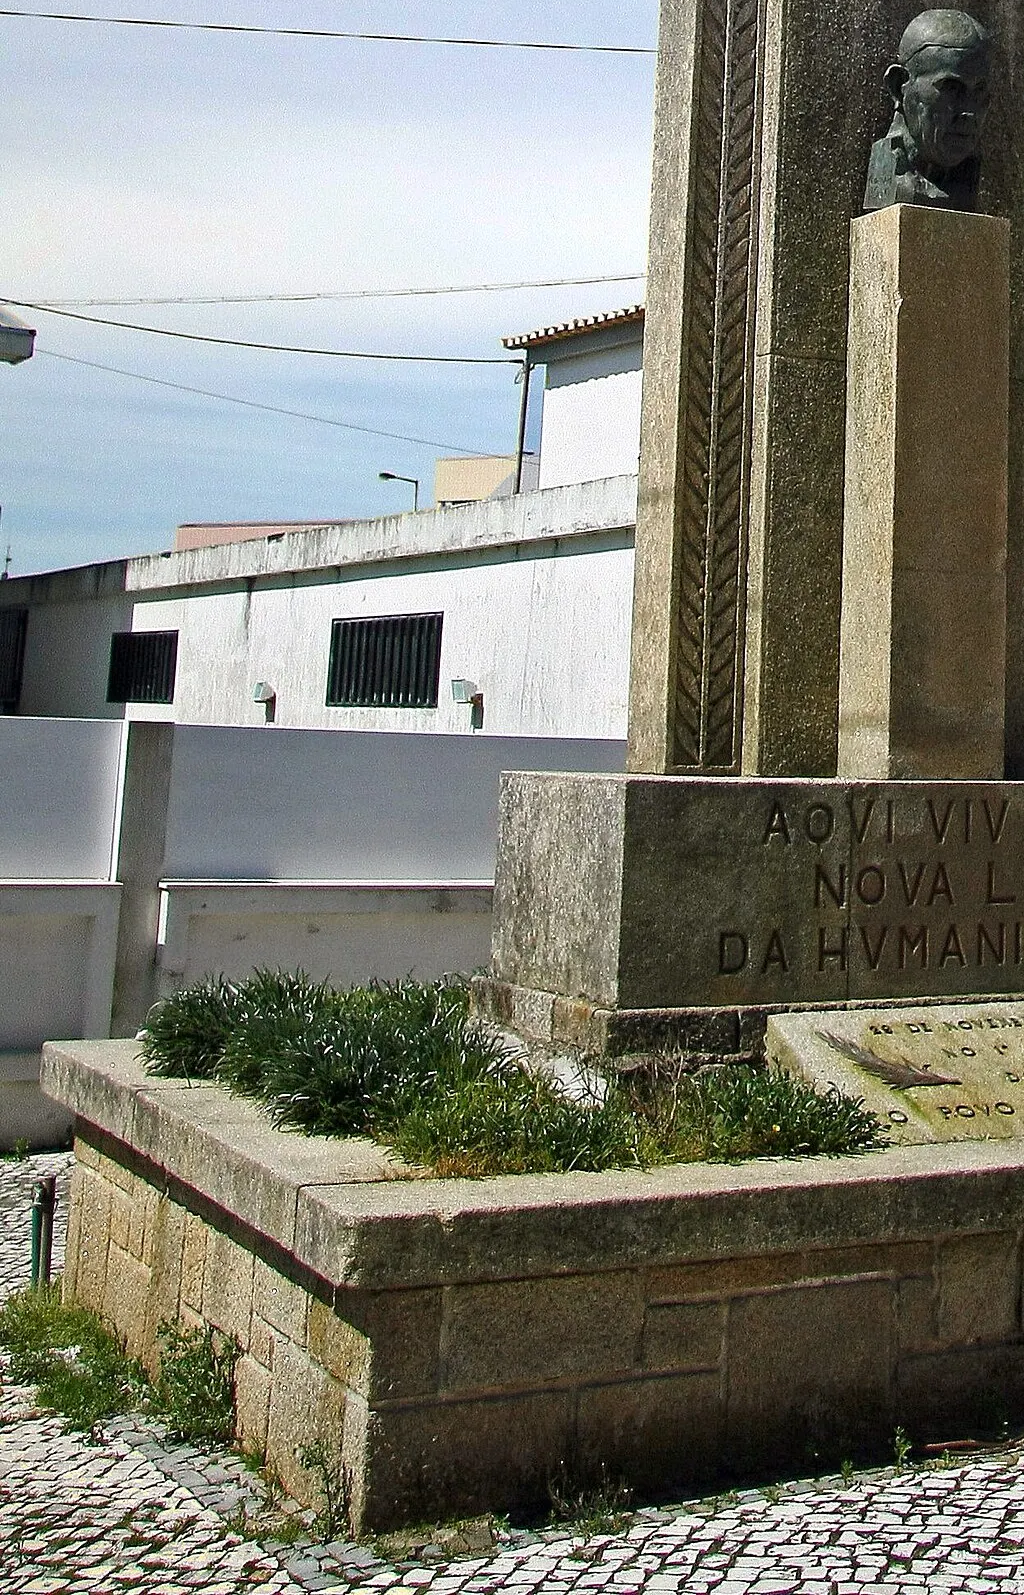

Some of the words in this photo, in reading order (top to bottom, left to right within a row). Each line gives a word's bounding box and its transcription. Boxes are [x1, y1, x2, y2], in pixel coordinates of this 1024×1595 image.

[926, 798, 1011, 845] VIV
[814, 862, 956, 910] NOVA
[718, 929, 791, 975] DA
[906, 1022, 933, 1034] DE
[941, 1047, 977, 1059] NO
[936, 1101, 1016, 1120] POVO
